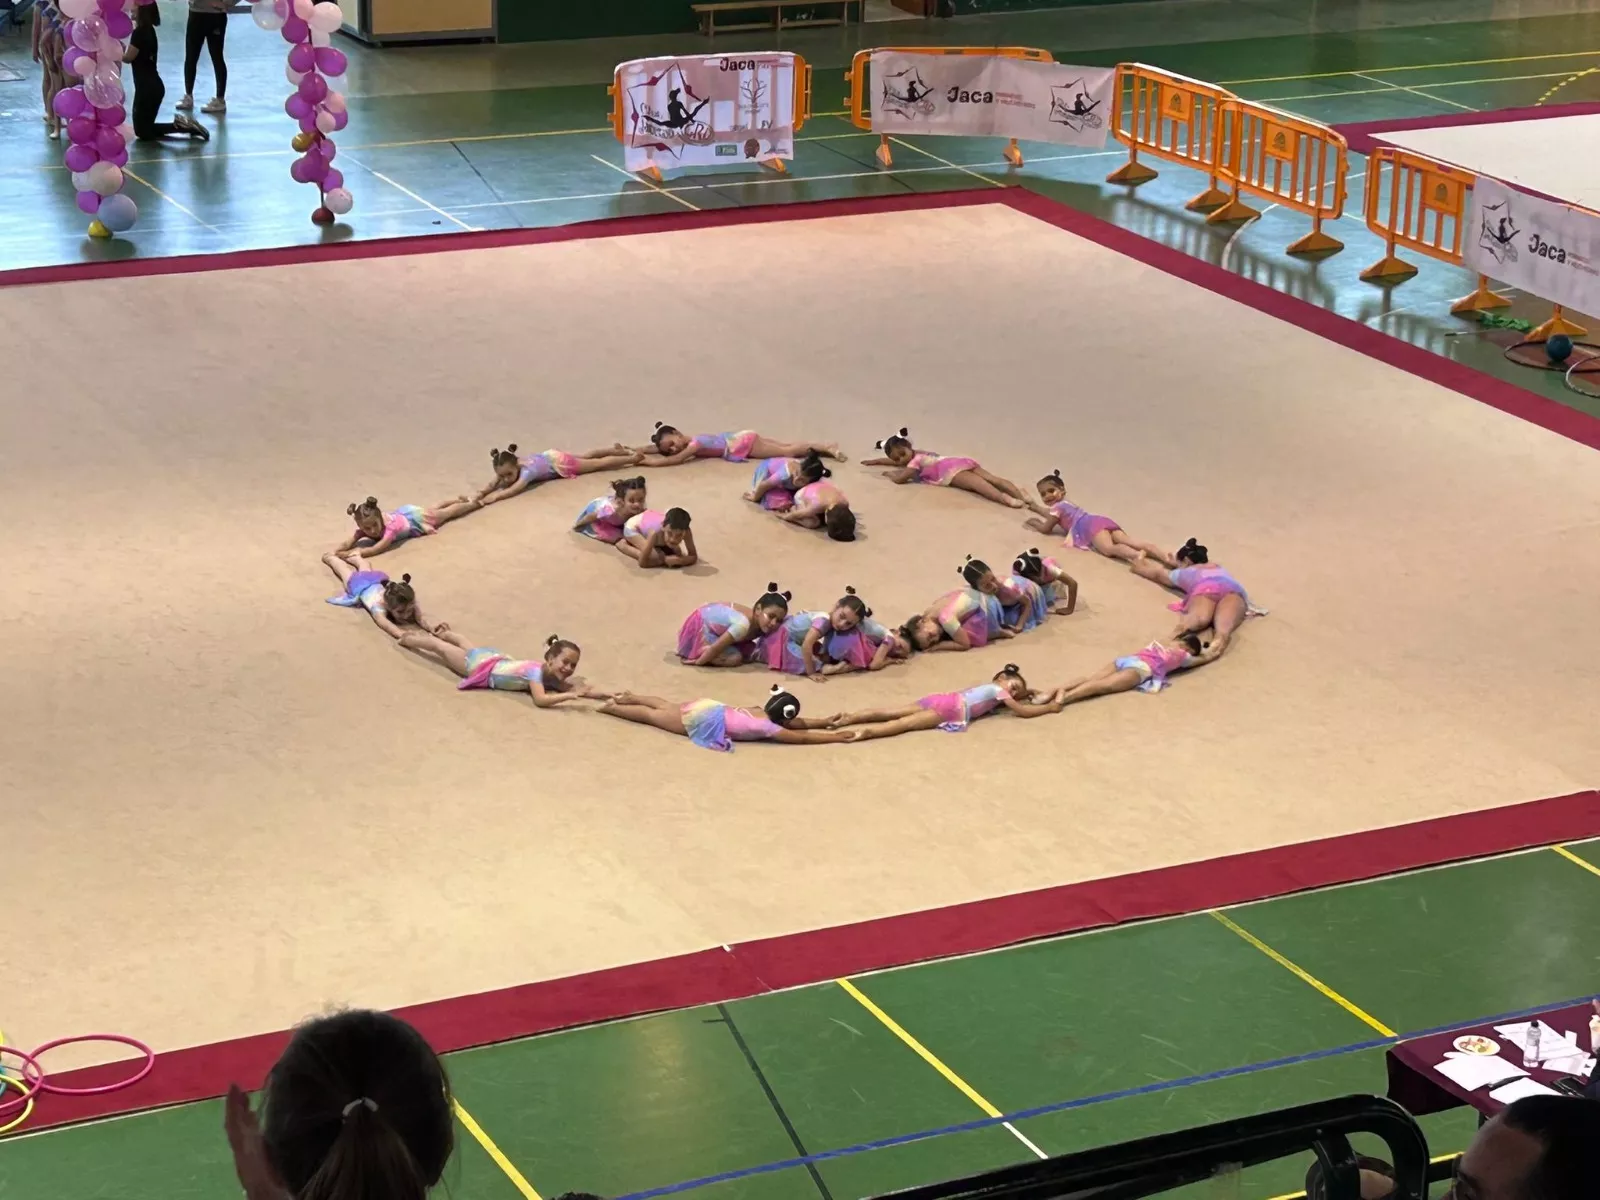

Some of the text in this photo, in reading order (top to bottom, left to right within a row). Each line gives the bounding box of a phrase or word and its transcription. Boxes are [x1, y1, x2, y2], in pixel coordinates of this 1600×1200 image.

[720, 57, 755, 71] Jaca
[947, 86, 993, 103] Jaca
[1528, 233, 1566, 264] Jaca
